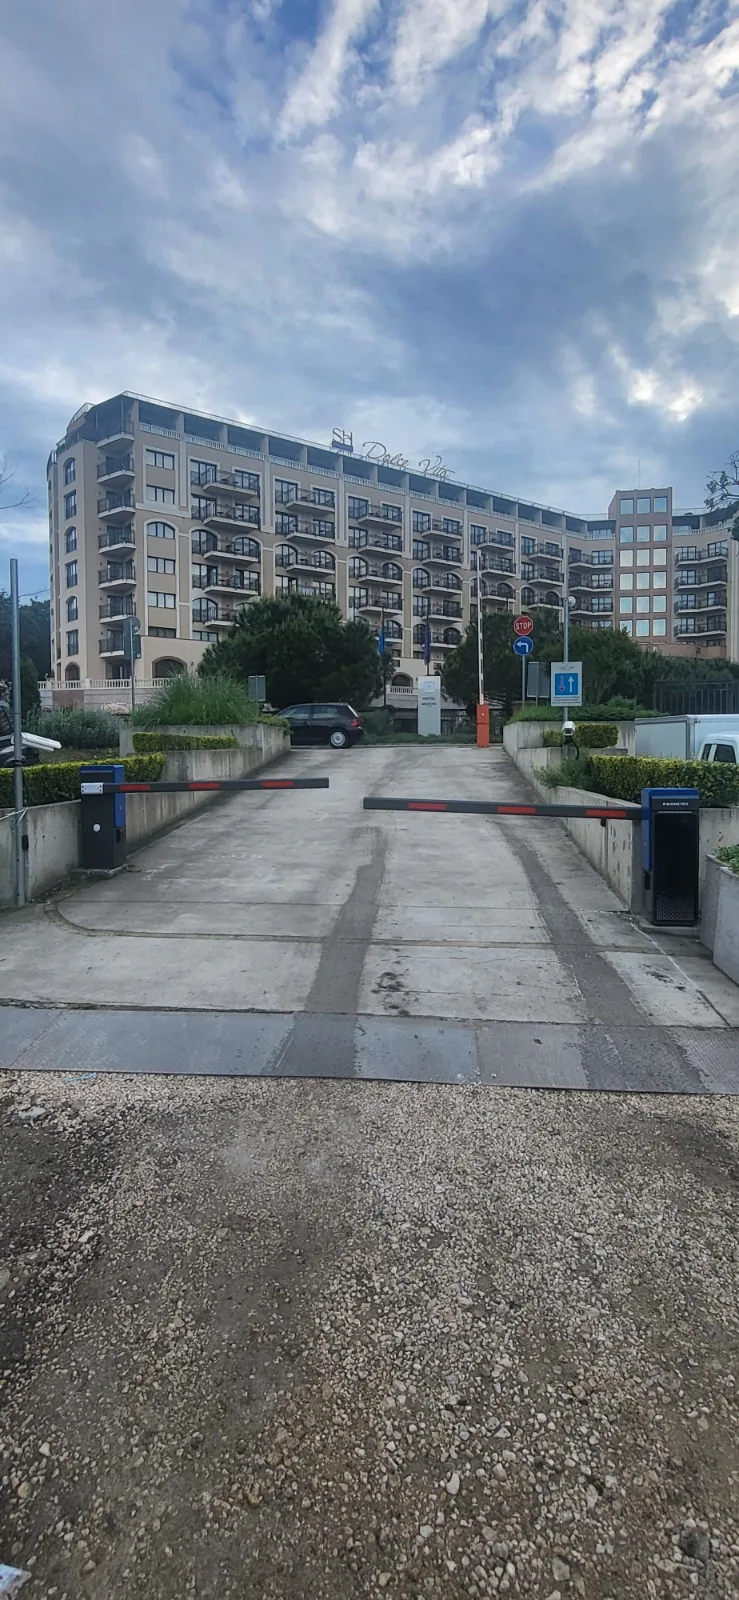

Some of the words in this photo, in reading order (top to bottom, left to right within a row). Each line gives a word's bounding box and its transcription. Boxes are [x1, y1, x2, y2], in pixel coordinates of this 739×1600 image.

[362, 441, 409, 467] Dolce
[418, 455, 456, 477] Vita
[515, 621, 532, 630] STOP
